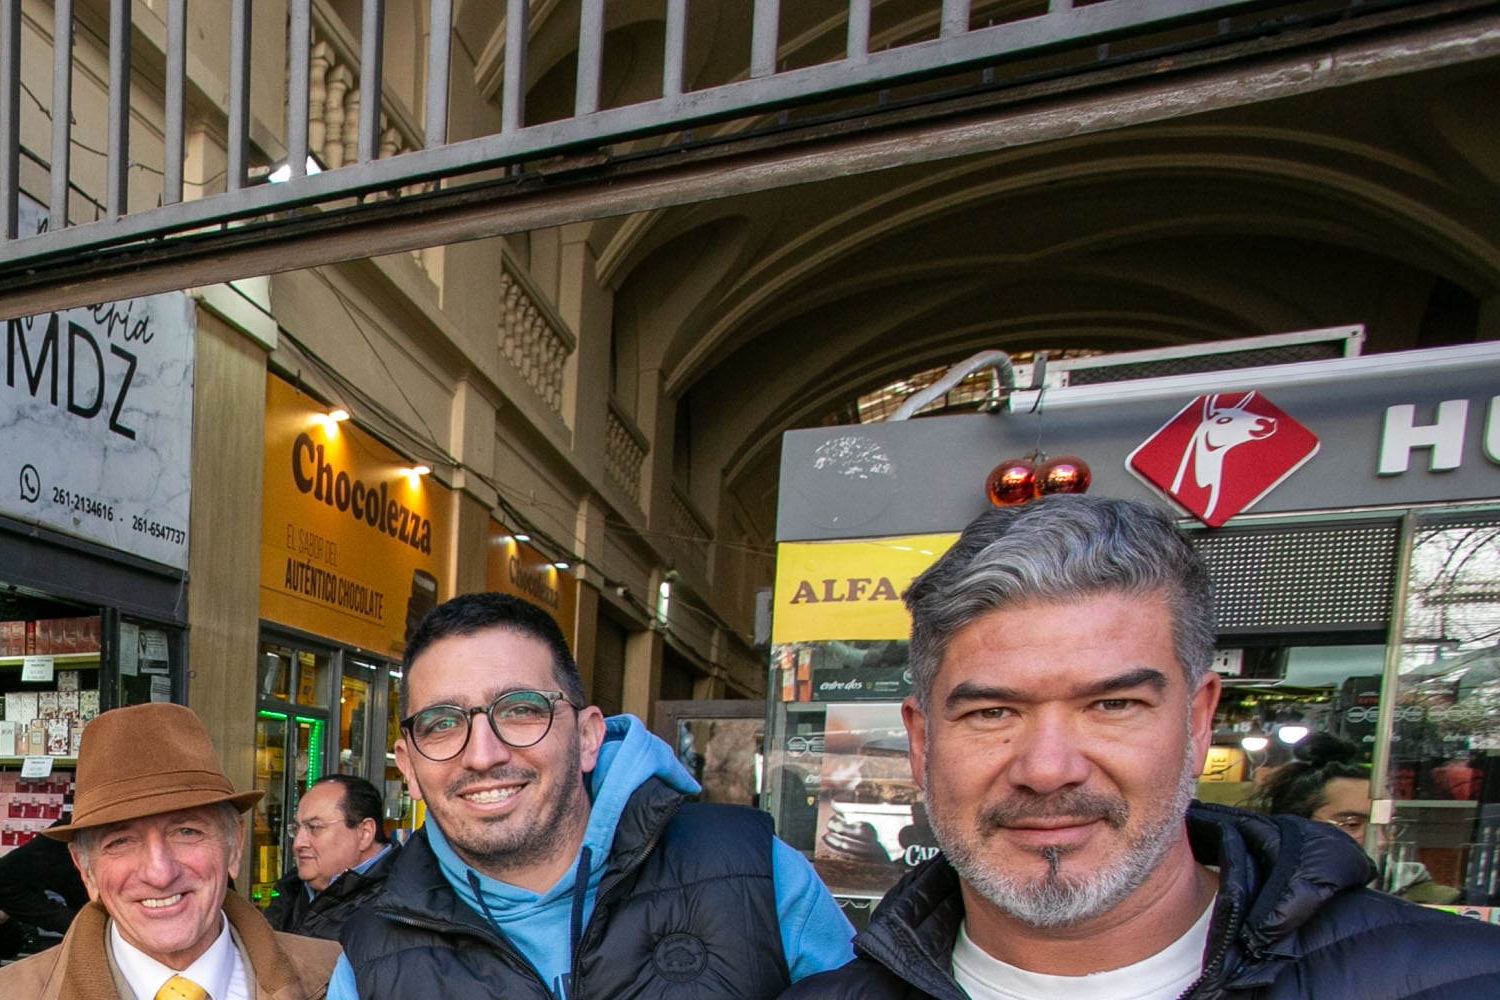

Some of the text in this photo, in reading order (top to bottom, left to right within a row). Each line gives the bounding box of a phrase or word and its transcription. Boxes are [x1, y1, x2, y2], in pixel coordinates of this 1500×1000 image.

[52, 486, 114, 522] 261-2134616
[132, 515, 186, 546] 261-6547737
[292, 433, 432, 556] Chocolezza
[285, 557, 384, 620] AUTÉNTICO CHOCOLATE
[789, 576, 914, 605] ALFA
